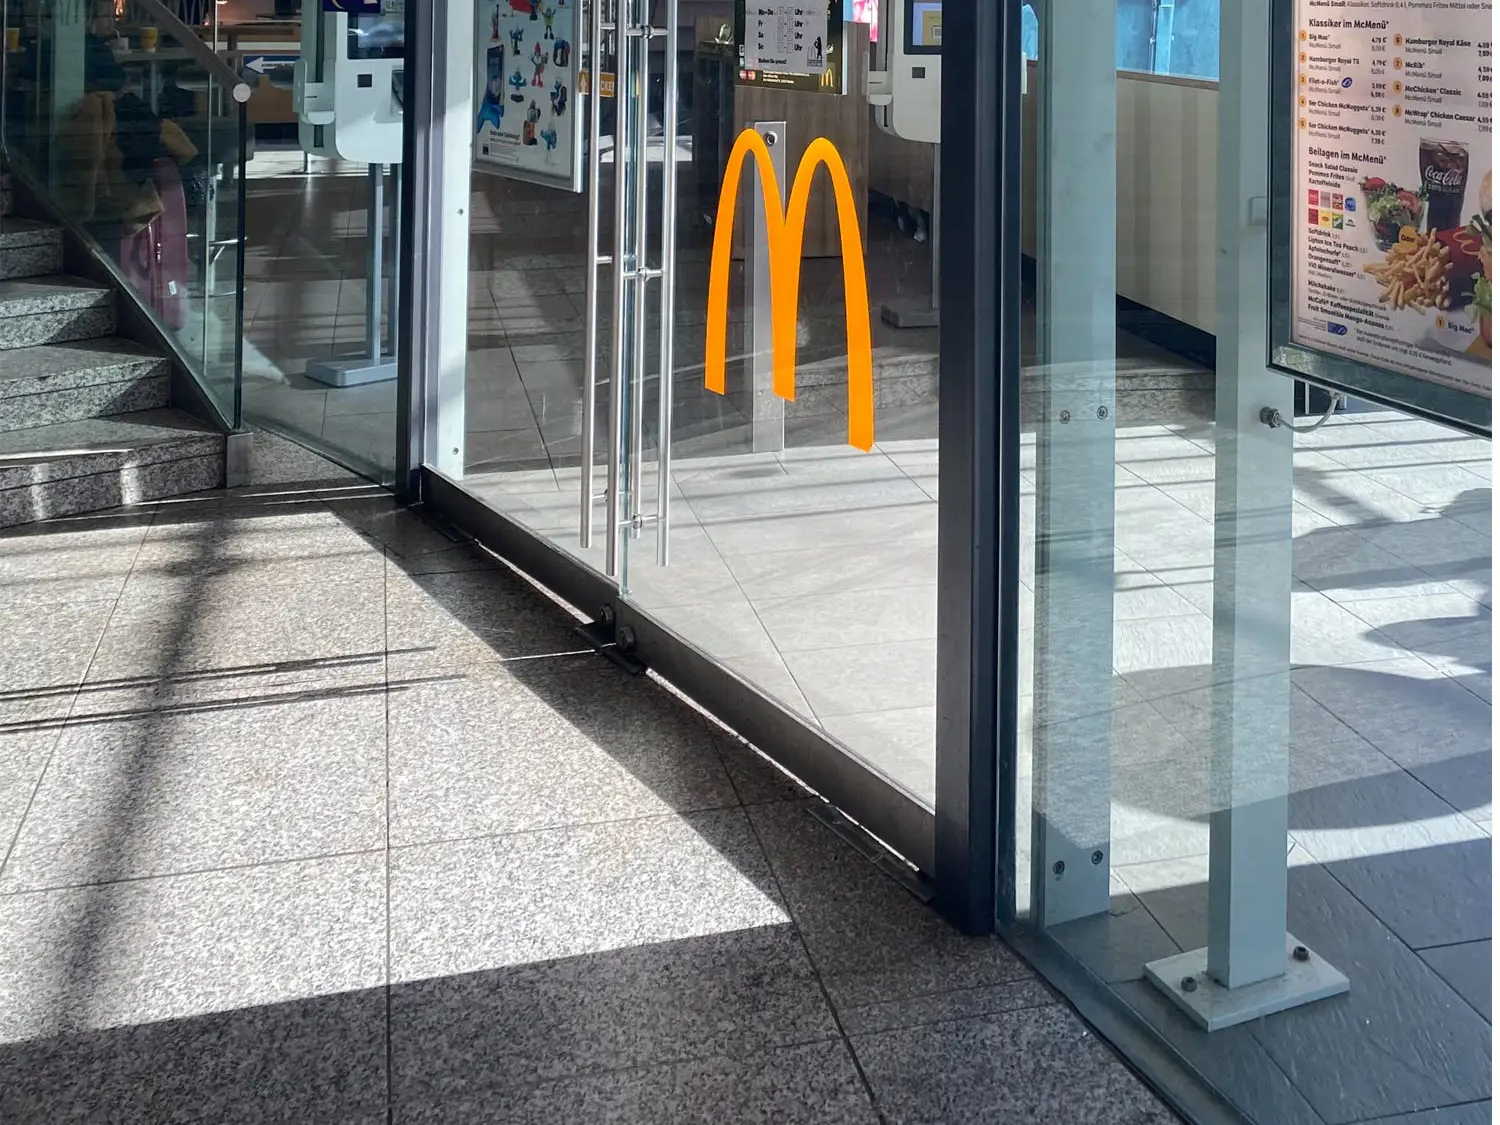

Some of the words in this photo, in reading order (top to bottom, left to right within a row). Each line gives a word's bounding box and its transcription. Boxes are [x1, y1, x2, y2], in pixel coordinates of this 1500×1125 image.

[1309, 18, 1341, 28] Klassiker
[1343, 20, 1352, 28] im
[1309, 147, 1339, 159] Beilagen
[1340, 150, 1350, 160] im
